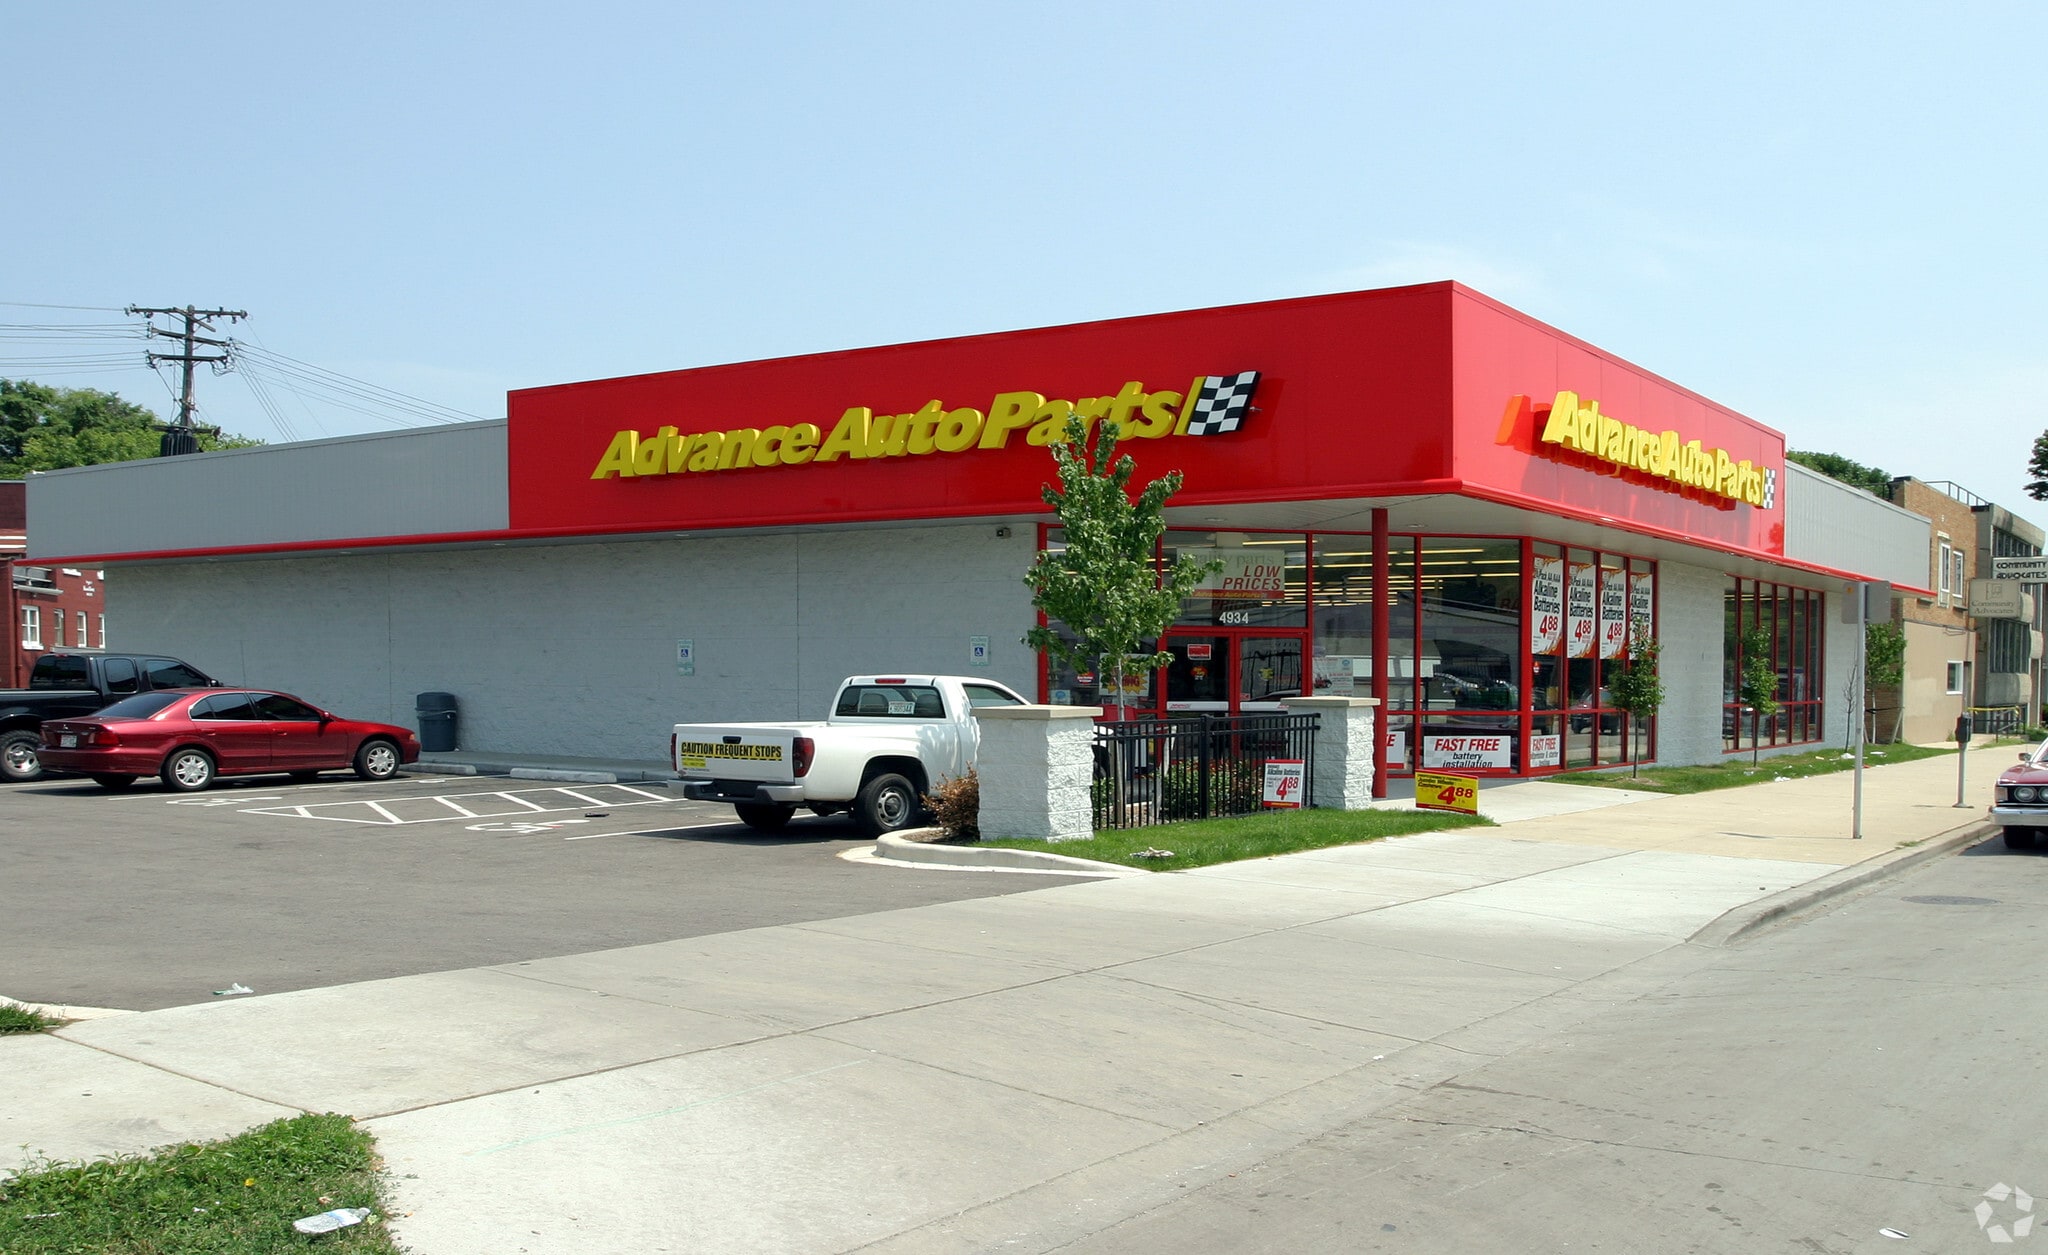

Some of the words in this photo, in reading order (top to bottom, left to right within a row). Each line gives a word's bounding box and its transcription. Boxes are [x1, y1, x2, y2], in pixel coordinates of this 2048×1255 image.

[590, 422, 819, 480] Advance
[814, 399, 984, 462] Auto
[978, 381, 1184, 449] Parts
[1541, 390, 1664, 474] Advance
[1653, 430, 1716, 492] Auto
[1709, 448, 1763, 506] Parts
[1243, 565, 1280, 578] LOW
[1222, 577, 1281, 590] PRICES
[1534, 580, 1558, 598] Alkaline
[1569, 586, 1591, 603] Alkaline
[1602, 591, 1622, 606] Alkaline
[1534, 596, 1560, 615] Batteries
[1569, 602, 1594, 618] Batteries
[1602, 606, 1624, 621] Batteries
[1219, 612, 1249, 624] 4934
[1539, 615, 1558, 639] 488
[1575, 620, 1592, 642] 488
[1607, 622, 1623, 644] 488
[681, 742, 714, 755] CAUTION
[715, 744, 753, 757] FREQUENT
[755, 746, 782, 758] STOPS
[1434, 738, 1466, 751] FAST
[1468, 738, 1500, 751] FREE
[1532, 738, 1545, 751] FAST
[1544, 737, 1557, 750] FREE
[1442, 760, 1493, 768] installation
[1452, 752, 1483, 760] battery
[1276, 777, 1299, 800] 488
[1437, 786, 1473, 804] 488
